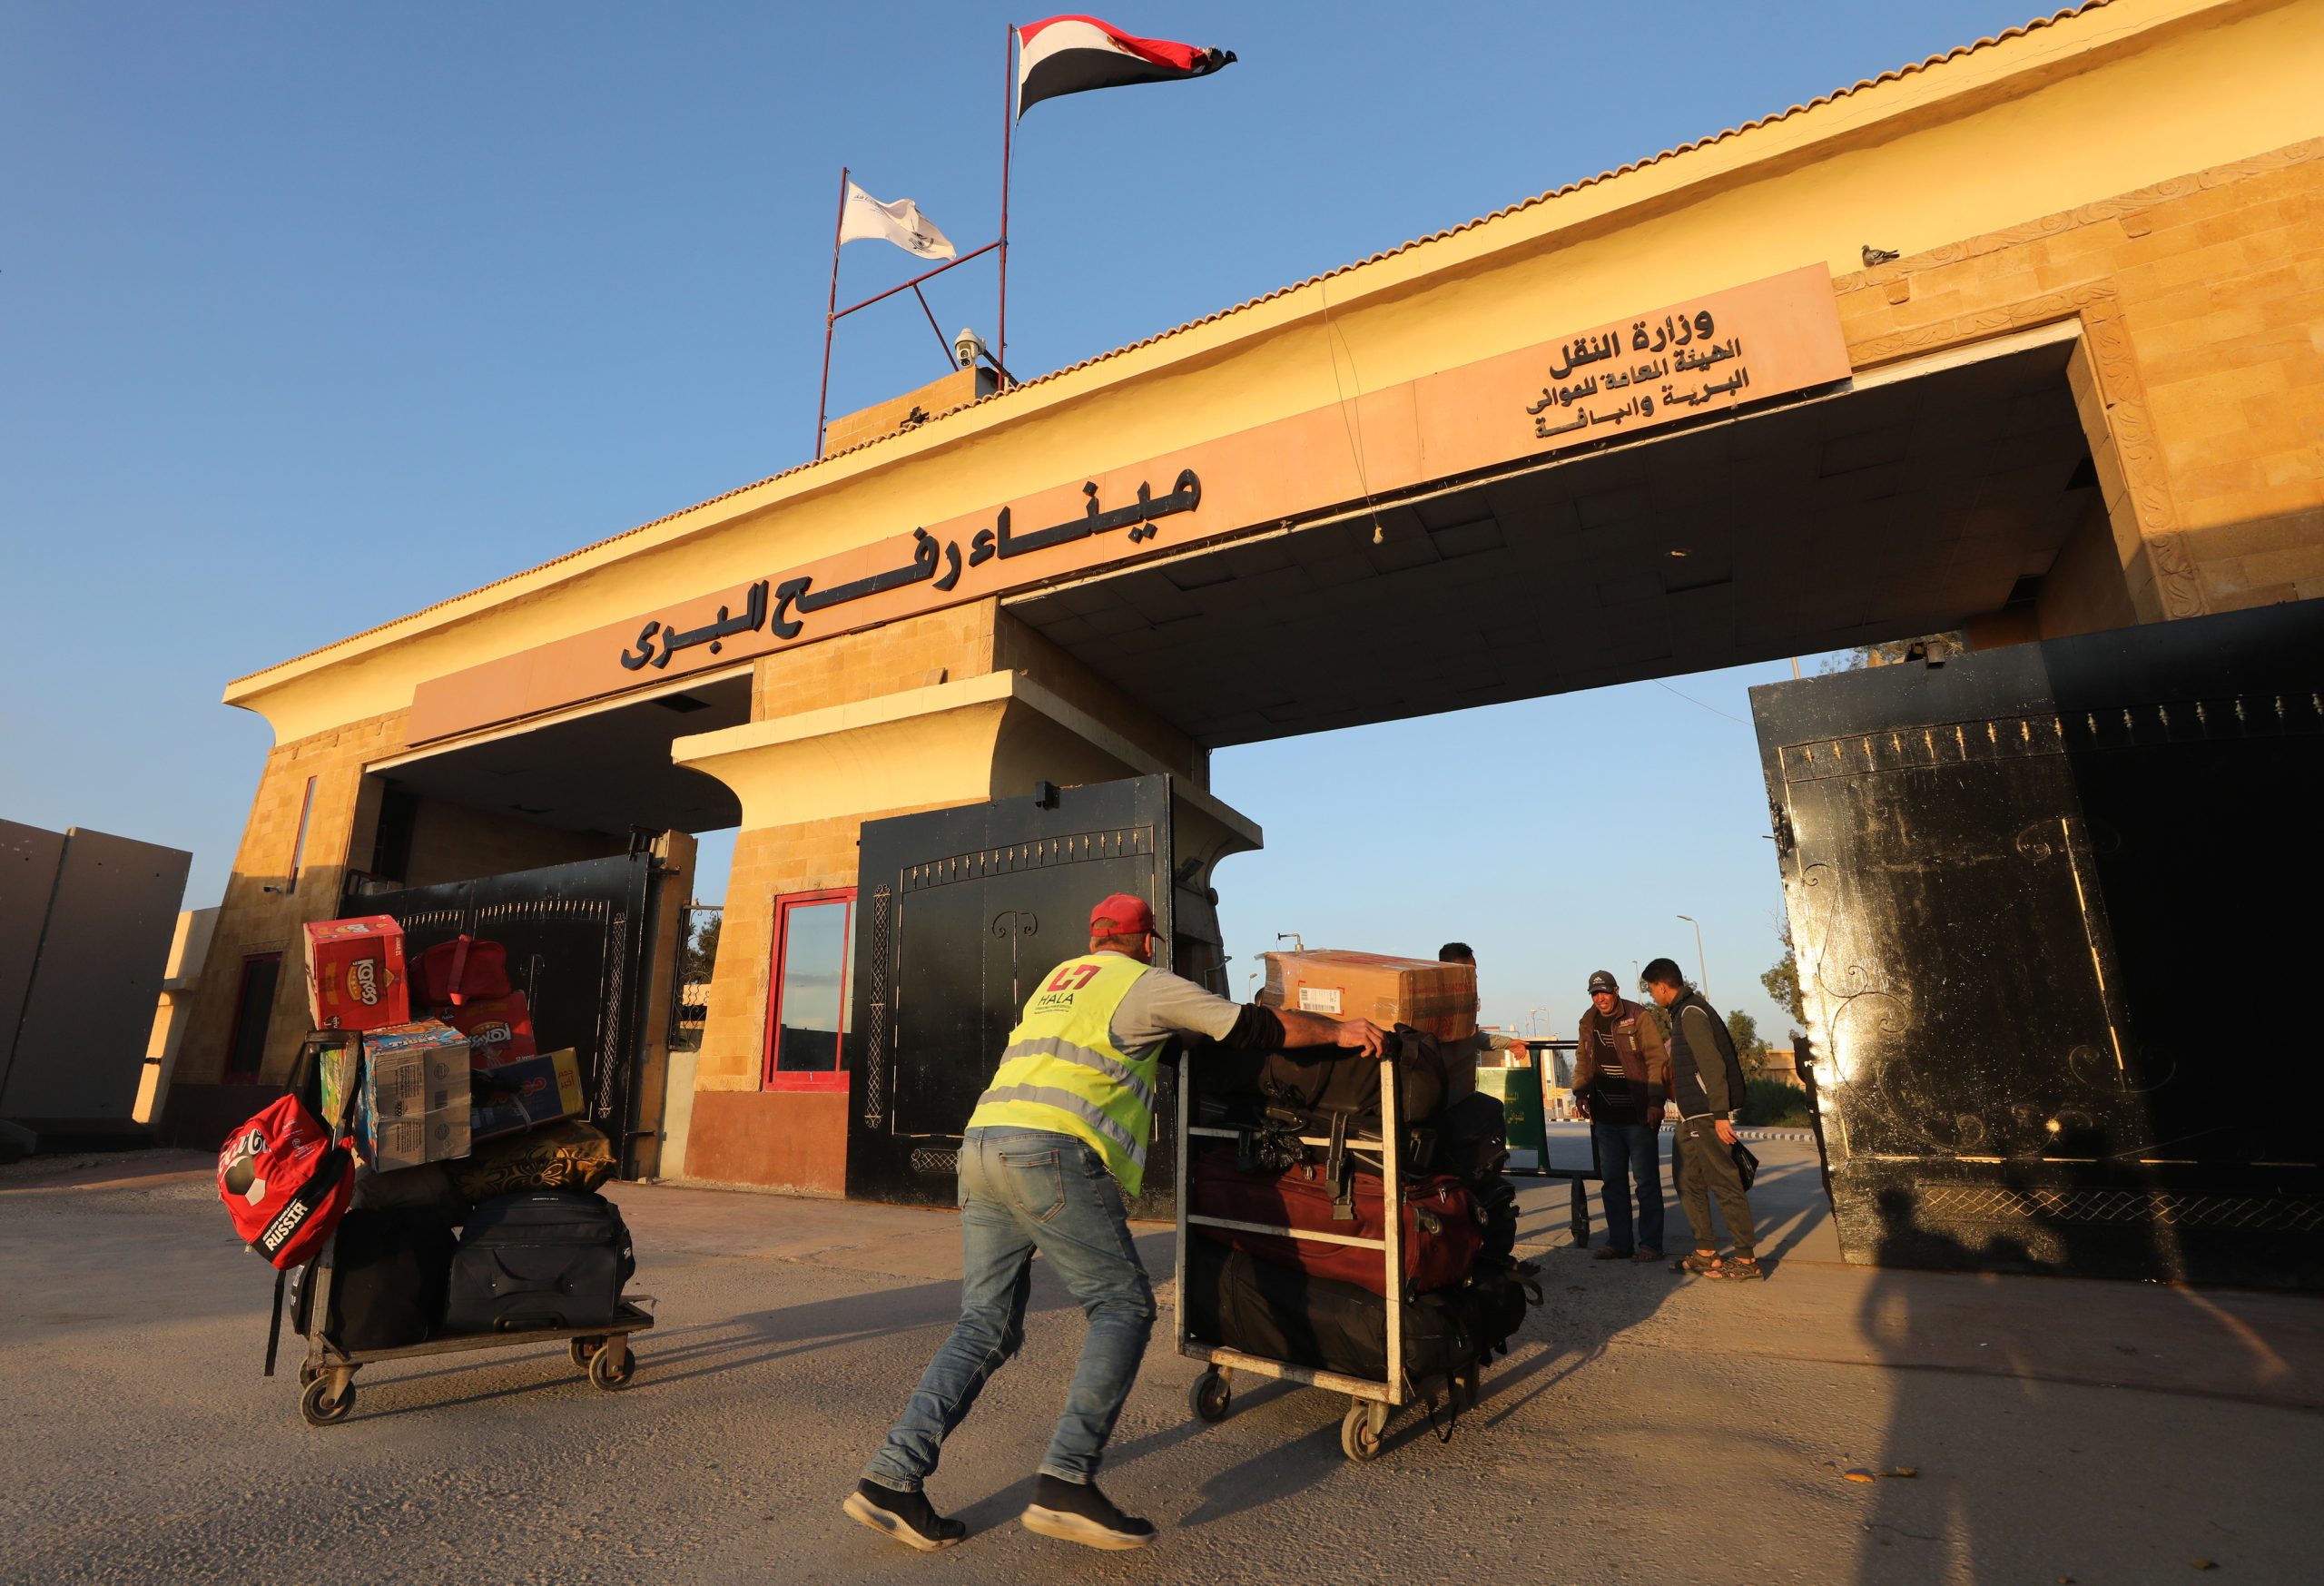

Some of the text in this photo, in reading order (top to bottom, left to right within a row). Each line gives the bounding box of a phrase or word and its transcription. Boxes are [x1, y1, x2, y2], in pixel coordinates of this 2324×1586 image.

[1549, 310, 1715, 379] وزارة النقل
[1600, 357, 1669, 390] العامة
[1673, 337, 1742, 372] الهيئة
[1535, 366, 1750, 438] البرية والجافة
[969, 468, 1202, 570] ميناء
[770, 526, 961, 639] رفح
[1037, 992, 1075, 1006] HALA
[265, 1202, 309, 1252] RUSSIA
